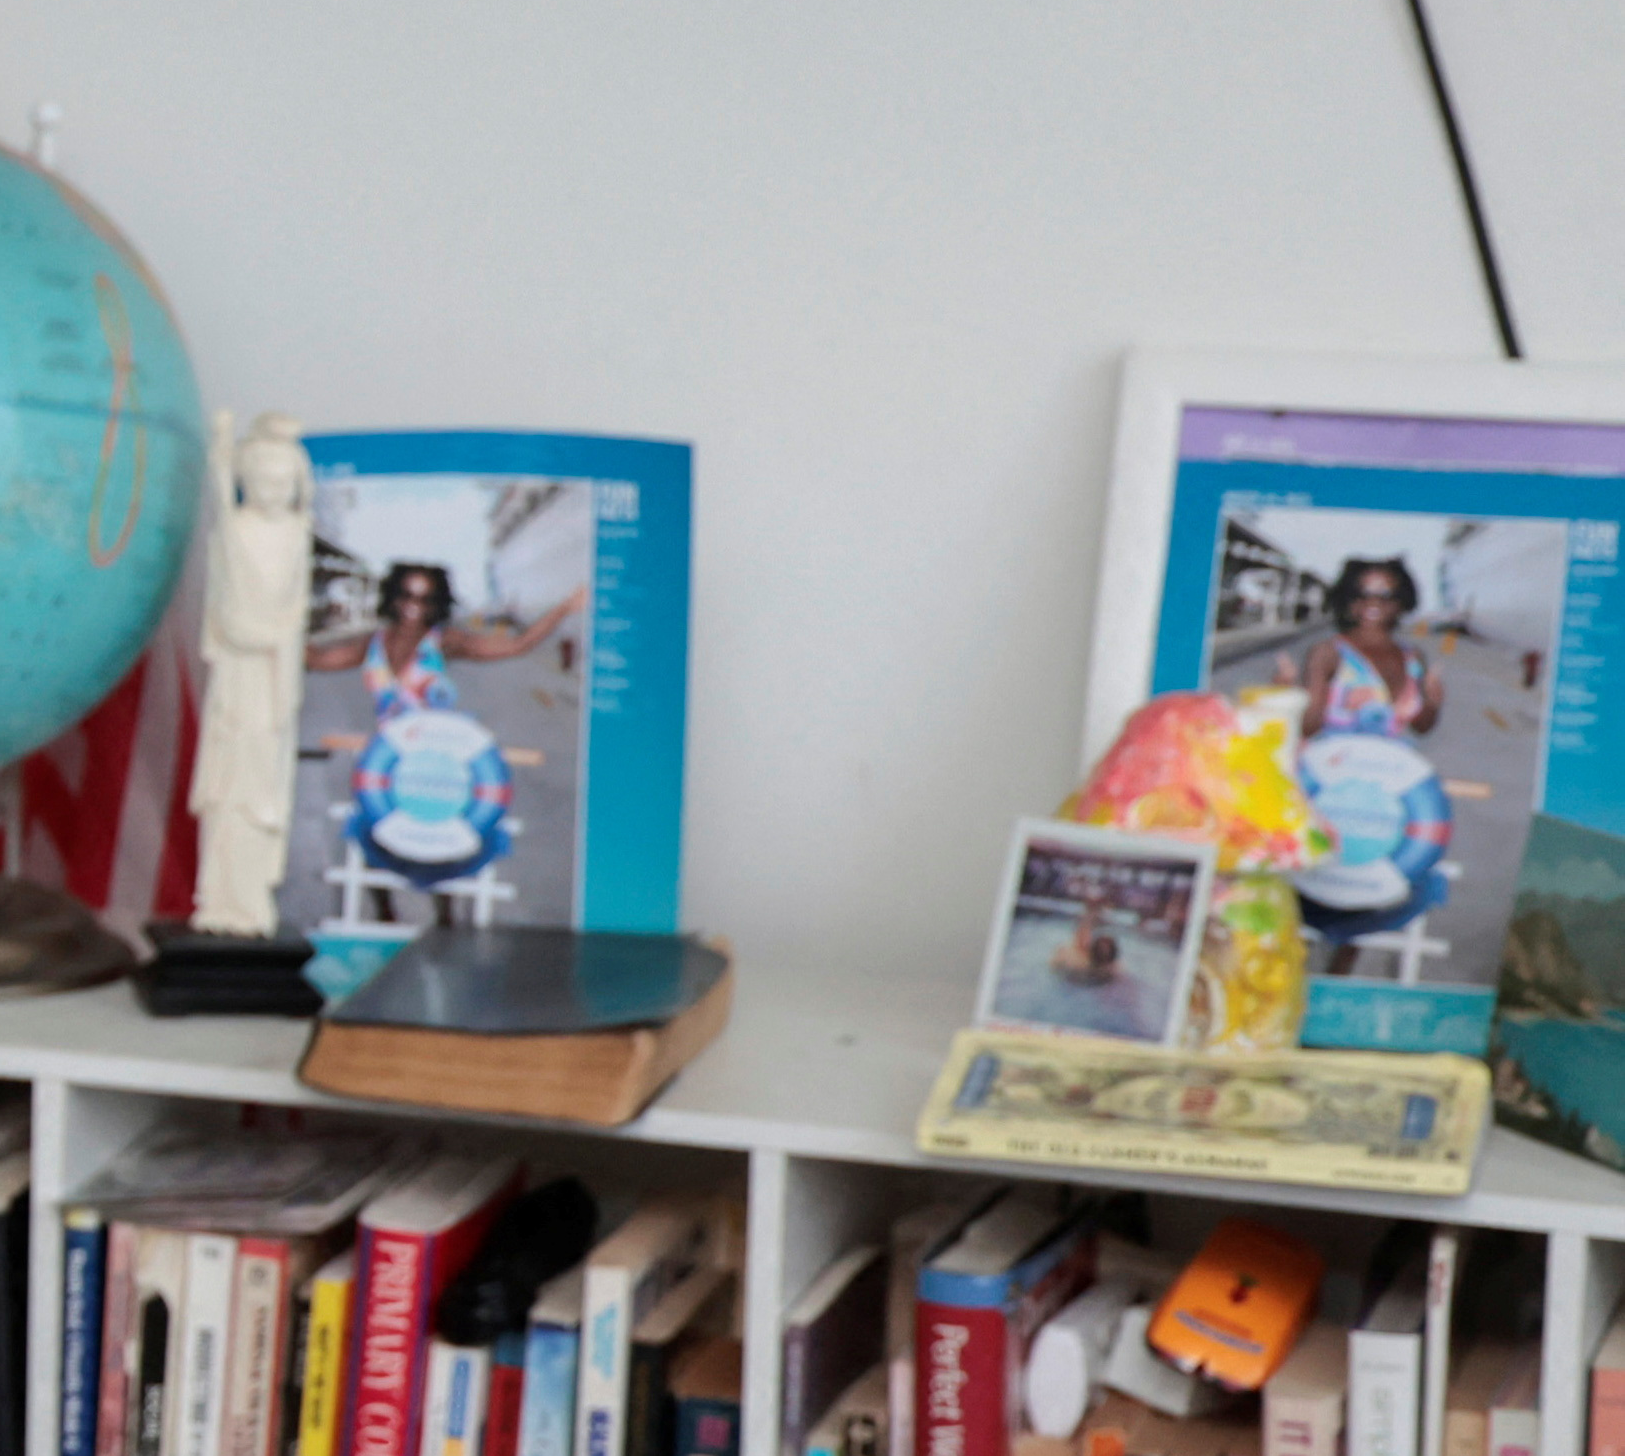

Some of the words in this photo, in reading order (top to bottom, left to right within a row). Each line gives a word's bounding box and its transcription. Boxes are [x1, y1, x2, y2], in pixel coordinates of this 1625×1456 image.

[364, 1239, 419, 1389] PRIMARY
[929, 1323, 969, 1436] Perfect
[1280, 1420, 1311, 1449] IT
